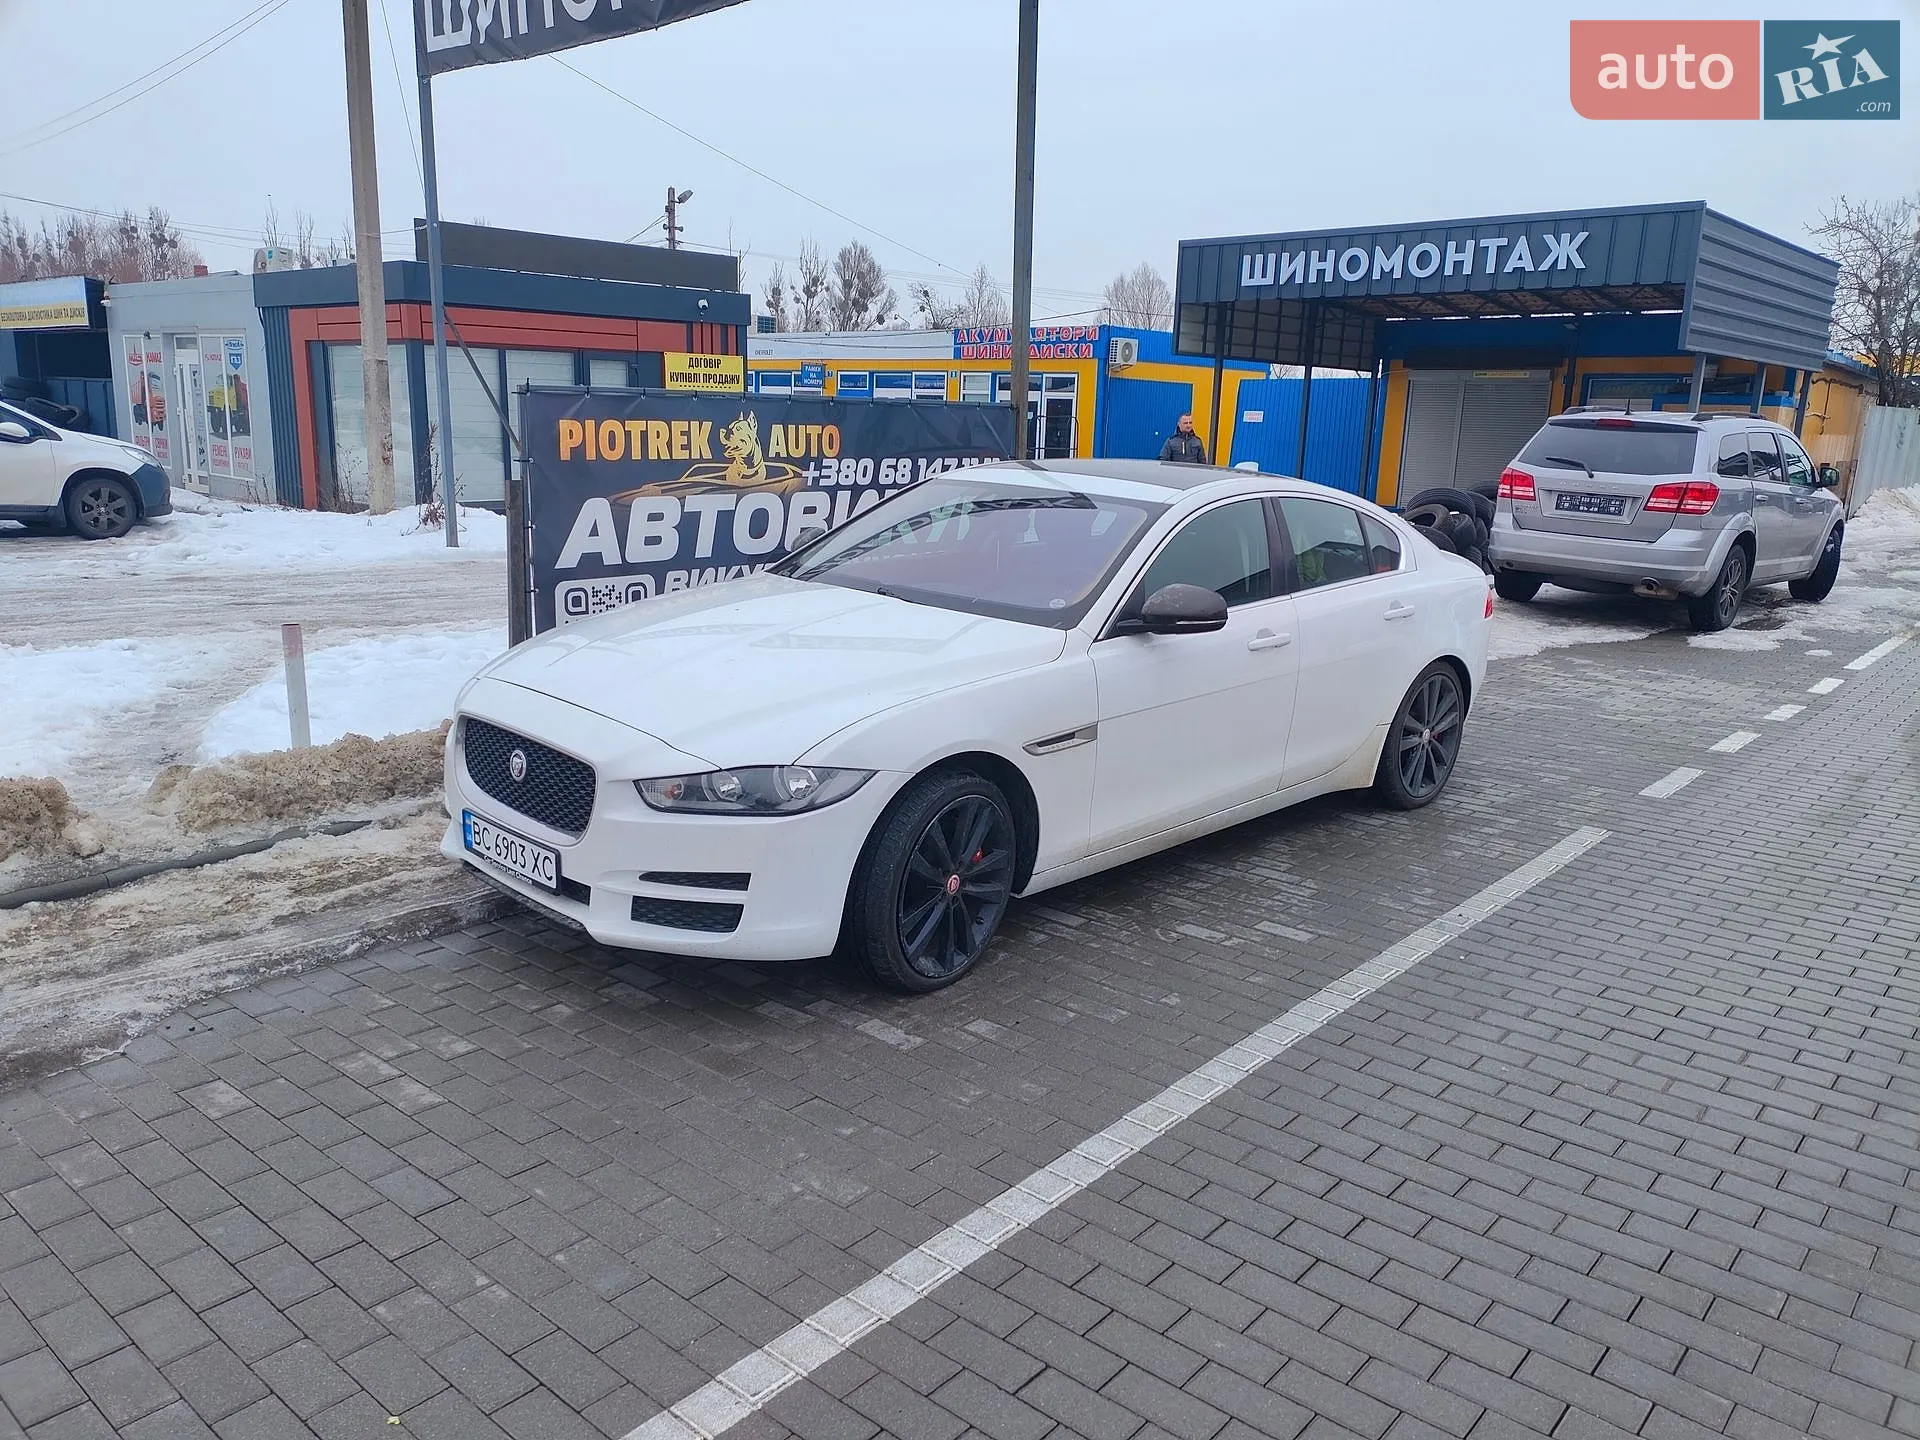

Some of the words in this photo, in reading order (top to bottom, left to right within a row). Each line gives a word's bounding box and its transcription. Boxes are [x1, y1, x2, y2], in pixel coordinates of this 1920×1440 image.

[1241, 231, 1590, 288] ШИНОМОНТАЖ
[956, 326, 1099, 343] АКУМЯТОРИ
[687, 356, 722, 370] ДОГОВІР
[669, 371, 701, 384] КУПІВЛІ
[702, 373, 740, 386] ПРОДАЖУ
[558, 419, 714, 462] PIOTREK
[768, 423, 841, 459] AUTO
[802, 457, 875, 486] +380
[878, 457, 913, 485] 68
[494, 833, 527, 869] 6903
